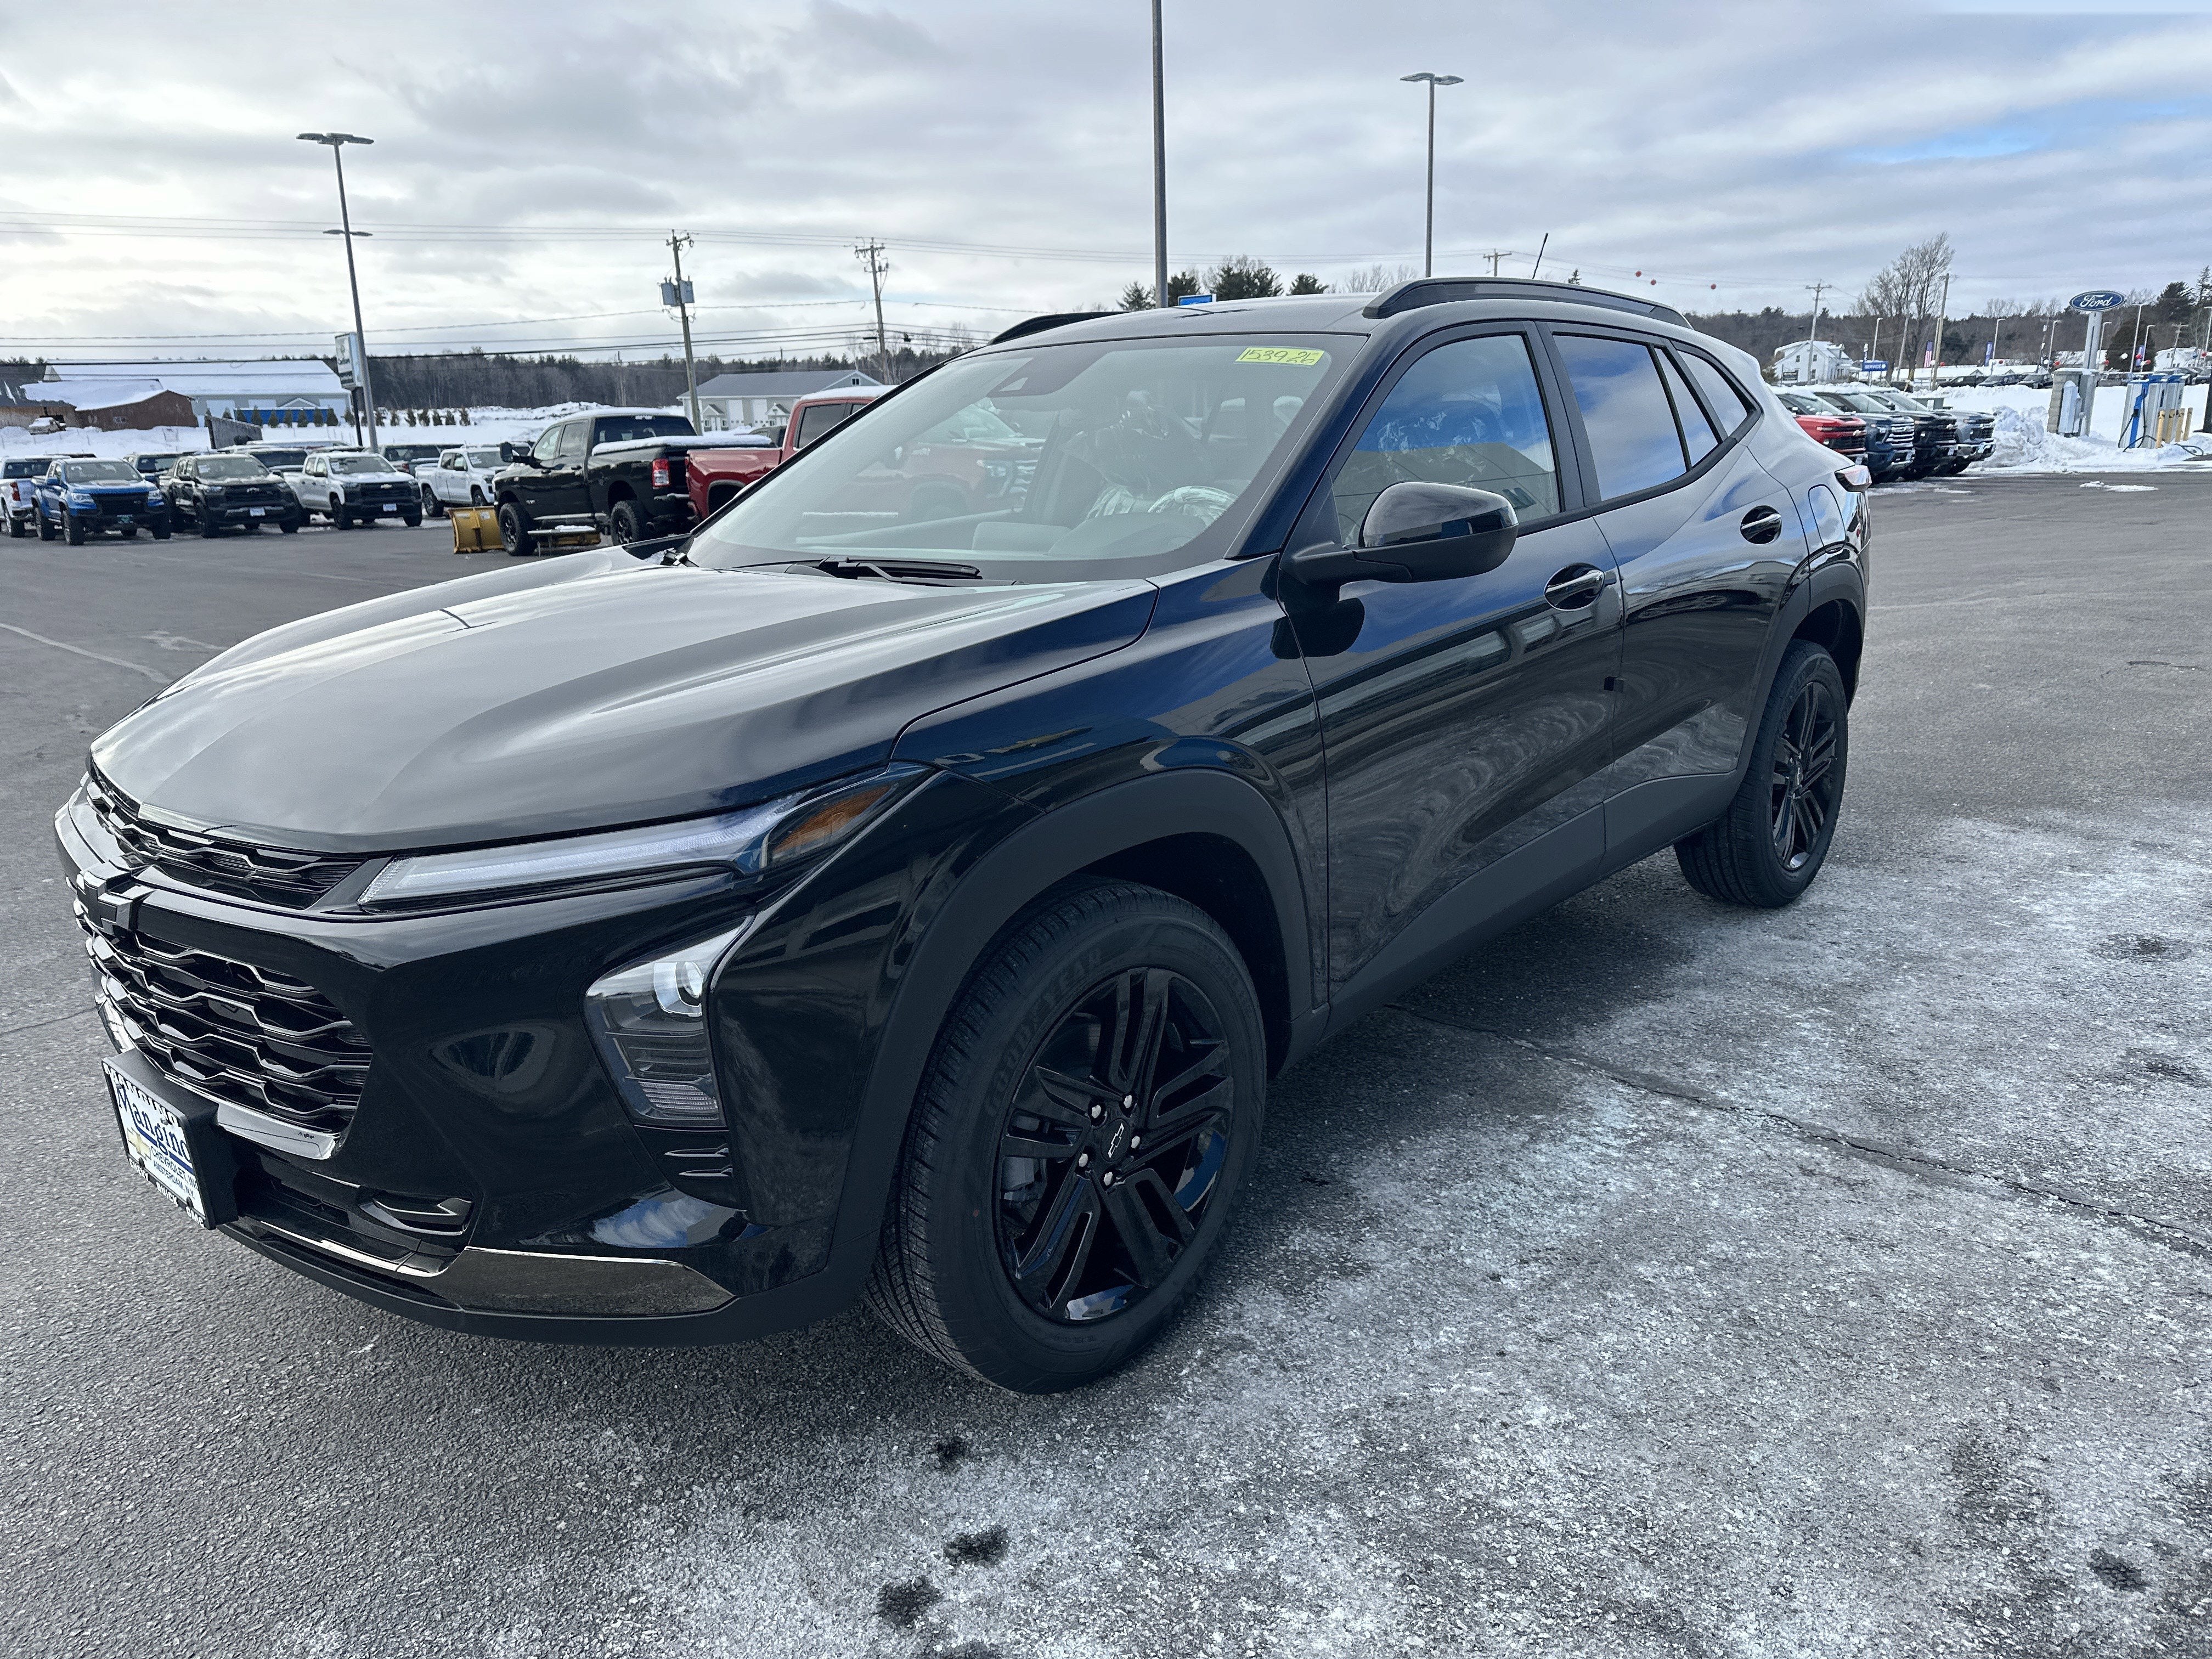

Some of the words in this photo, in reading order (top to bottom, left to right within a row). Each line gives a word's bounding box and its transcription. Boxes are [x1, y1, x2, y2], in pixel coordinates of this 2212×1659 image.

[2080, 294, 2113, 307] Ford
[116, 1086, 192, 1163] Mangino
[129, 1158, 149, 1181] CHEVY
[156, 1181, 179, 1207] BUICK
[185, 1206, 205, 1228] GMC
